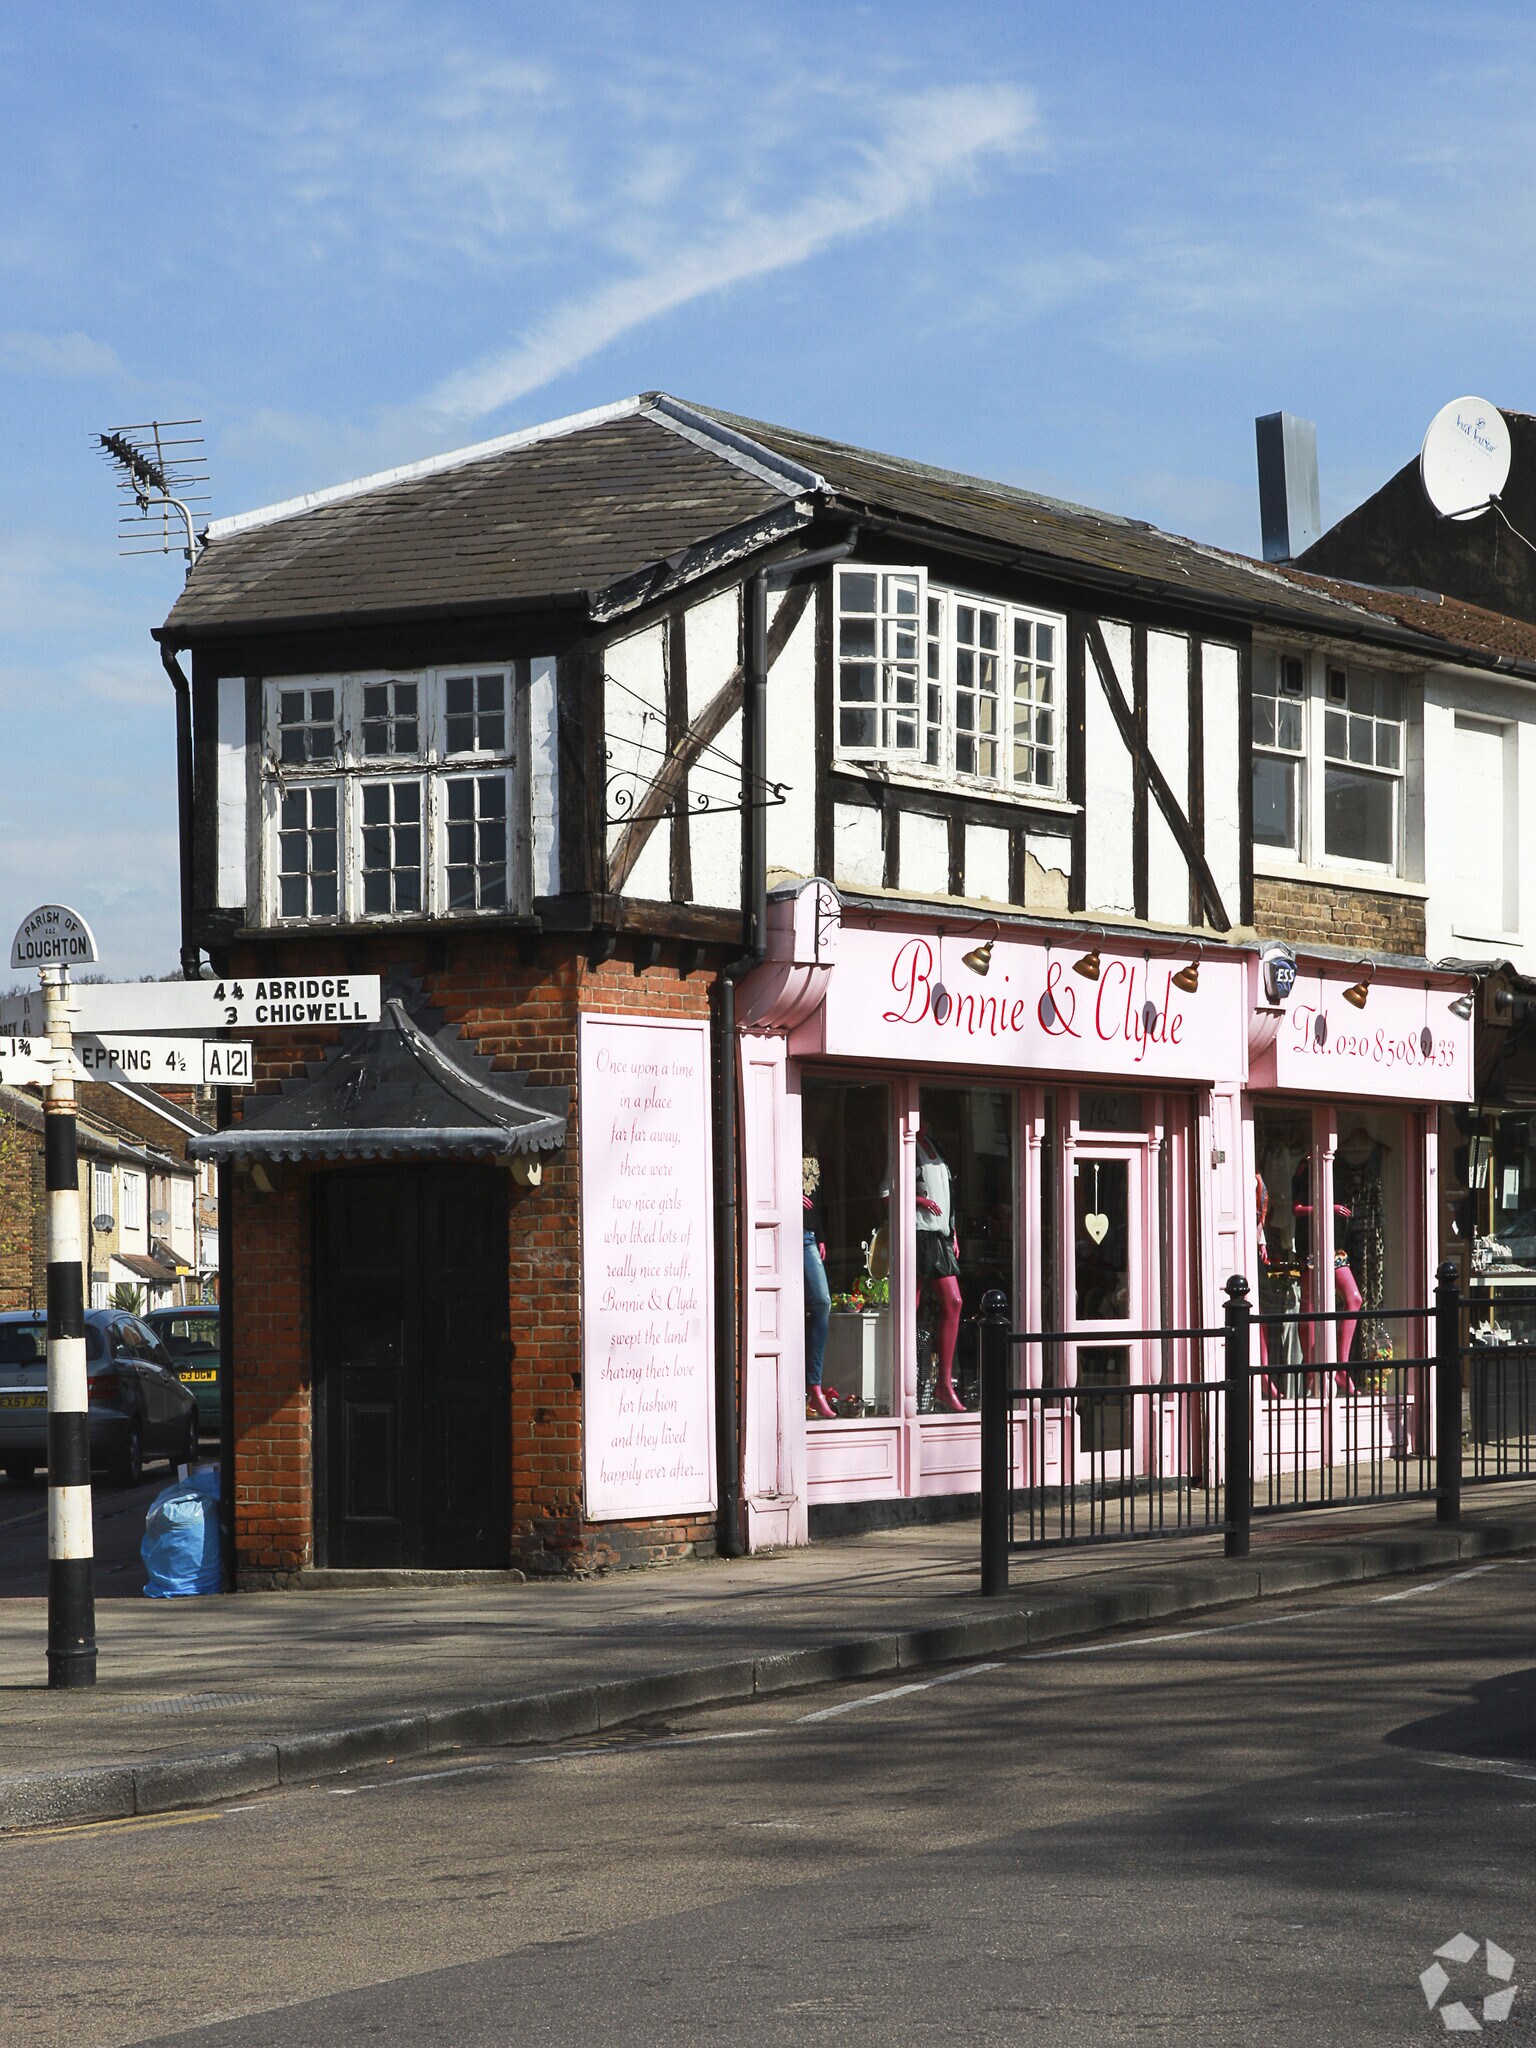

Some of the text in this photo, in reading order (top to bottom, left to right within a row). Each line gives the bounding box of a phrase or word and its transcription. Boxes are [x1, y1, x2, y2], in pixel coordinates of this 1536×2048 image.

[24, 911, 78, 937] PARISH OF
[17, 936, 87, 960] LOUGHTON
[255, 979, 350, 1000] ABRIDGE
[1276, 968, 1296, 983] ESS
[223, 1002, 368, 1025] 3 CHIGWELL
[882, 938, 1183, 1062] Bonnie & Clyde
[1292, 1004, 1331, 1055] Tel.
[1336, 1035, 1369, 1057] 020
[82, 1047, 151, 1071] EPPING
[597, 1047, 694, 1079] Once upon a time
[620, 1085, 672, 1113] in a place
[610, 1116, 627, 1145] far
[630, 1117, 646, 1145] far
[620, 1153, 673, 1177] there were
[612, 1187, 682, 1216] two nice girls
[604, 1219, 694, 1248] who liked lots of
[606, 1254, 637, 1283] really
[640, 1260, 661, 1278] nice
[600, 1286, 698, 1315] Bonnie & Clyde
[610, 1320, 690, 1350] swept the land
[600, 1354, 695, 1384] sharing their love
[618, 1388, 679, 1418] for fashion
[611, 1420, 688, 1451] and they lived
[600, 1458, 642, 1486] happily
[645, 1466, 666, 1479] ever
